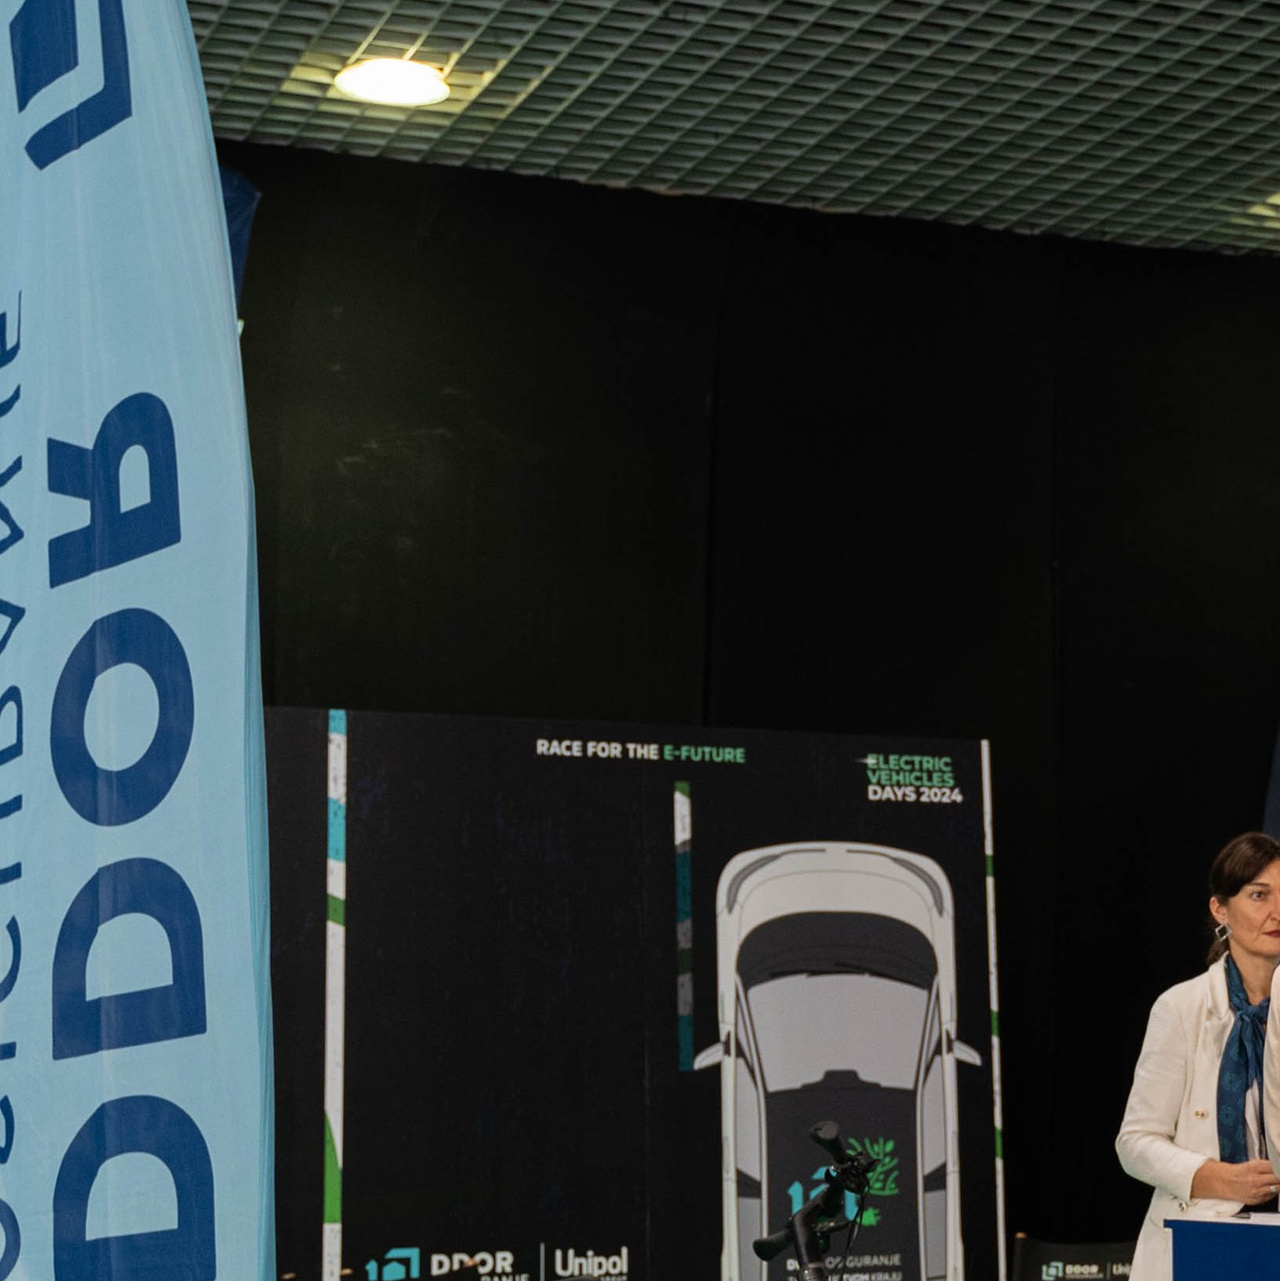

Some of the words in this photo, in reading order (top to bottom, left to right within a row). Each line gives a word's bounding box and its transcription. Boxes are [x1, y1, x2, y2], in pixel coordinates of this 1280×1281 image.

[536, 739, 582, 757] RACE
[587, 741, 622, 759] FOR
[626, 743, 660, 760] THE
[663, 744, 746, 763] E-FUTURE
[867, 753, 952, 771] ELECTRIC
[867, 769, 955, 787] VEHICLES
[867, 785, 916, 801] DAYS
[919, 787, 963, 803] 2024
[555, 1246, 628, 1278] Unipol
